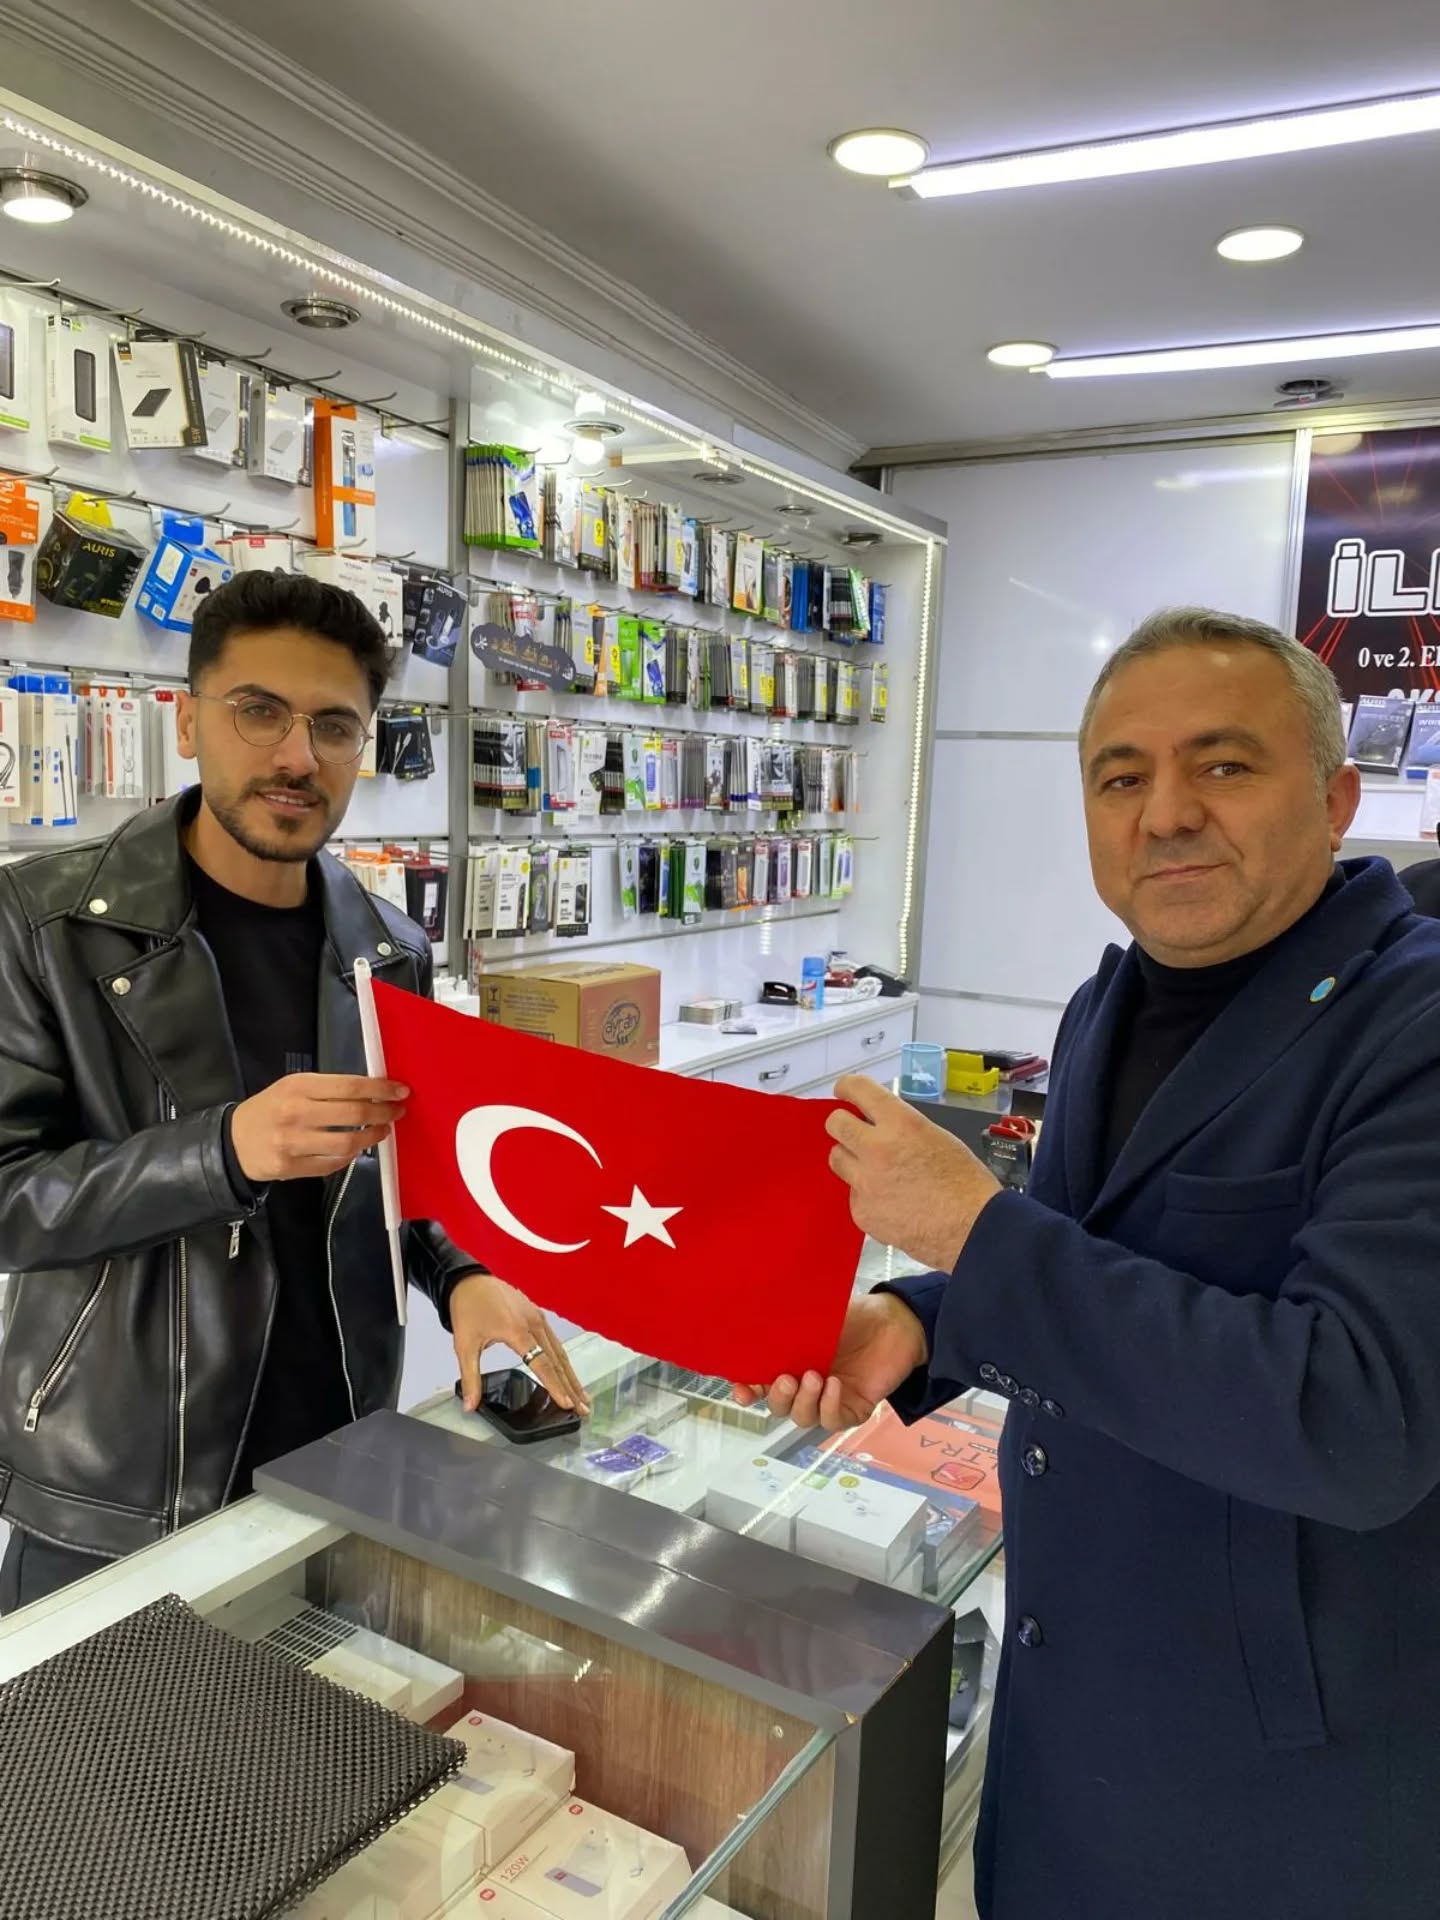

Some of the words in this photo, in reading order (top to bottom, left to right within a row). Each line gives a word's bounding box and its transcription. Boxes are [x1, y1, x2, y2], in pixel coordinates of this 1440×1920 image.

[82, 542, 117, 558] AURIS
[1358, 647, 1370, 668] 0
[1373, 653, 1395, 668] ve
[1397, 646, 1415, 668] 2.
[501, 1855, 530, 1881] 120W
